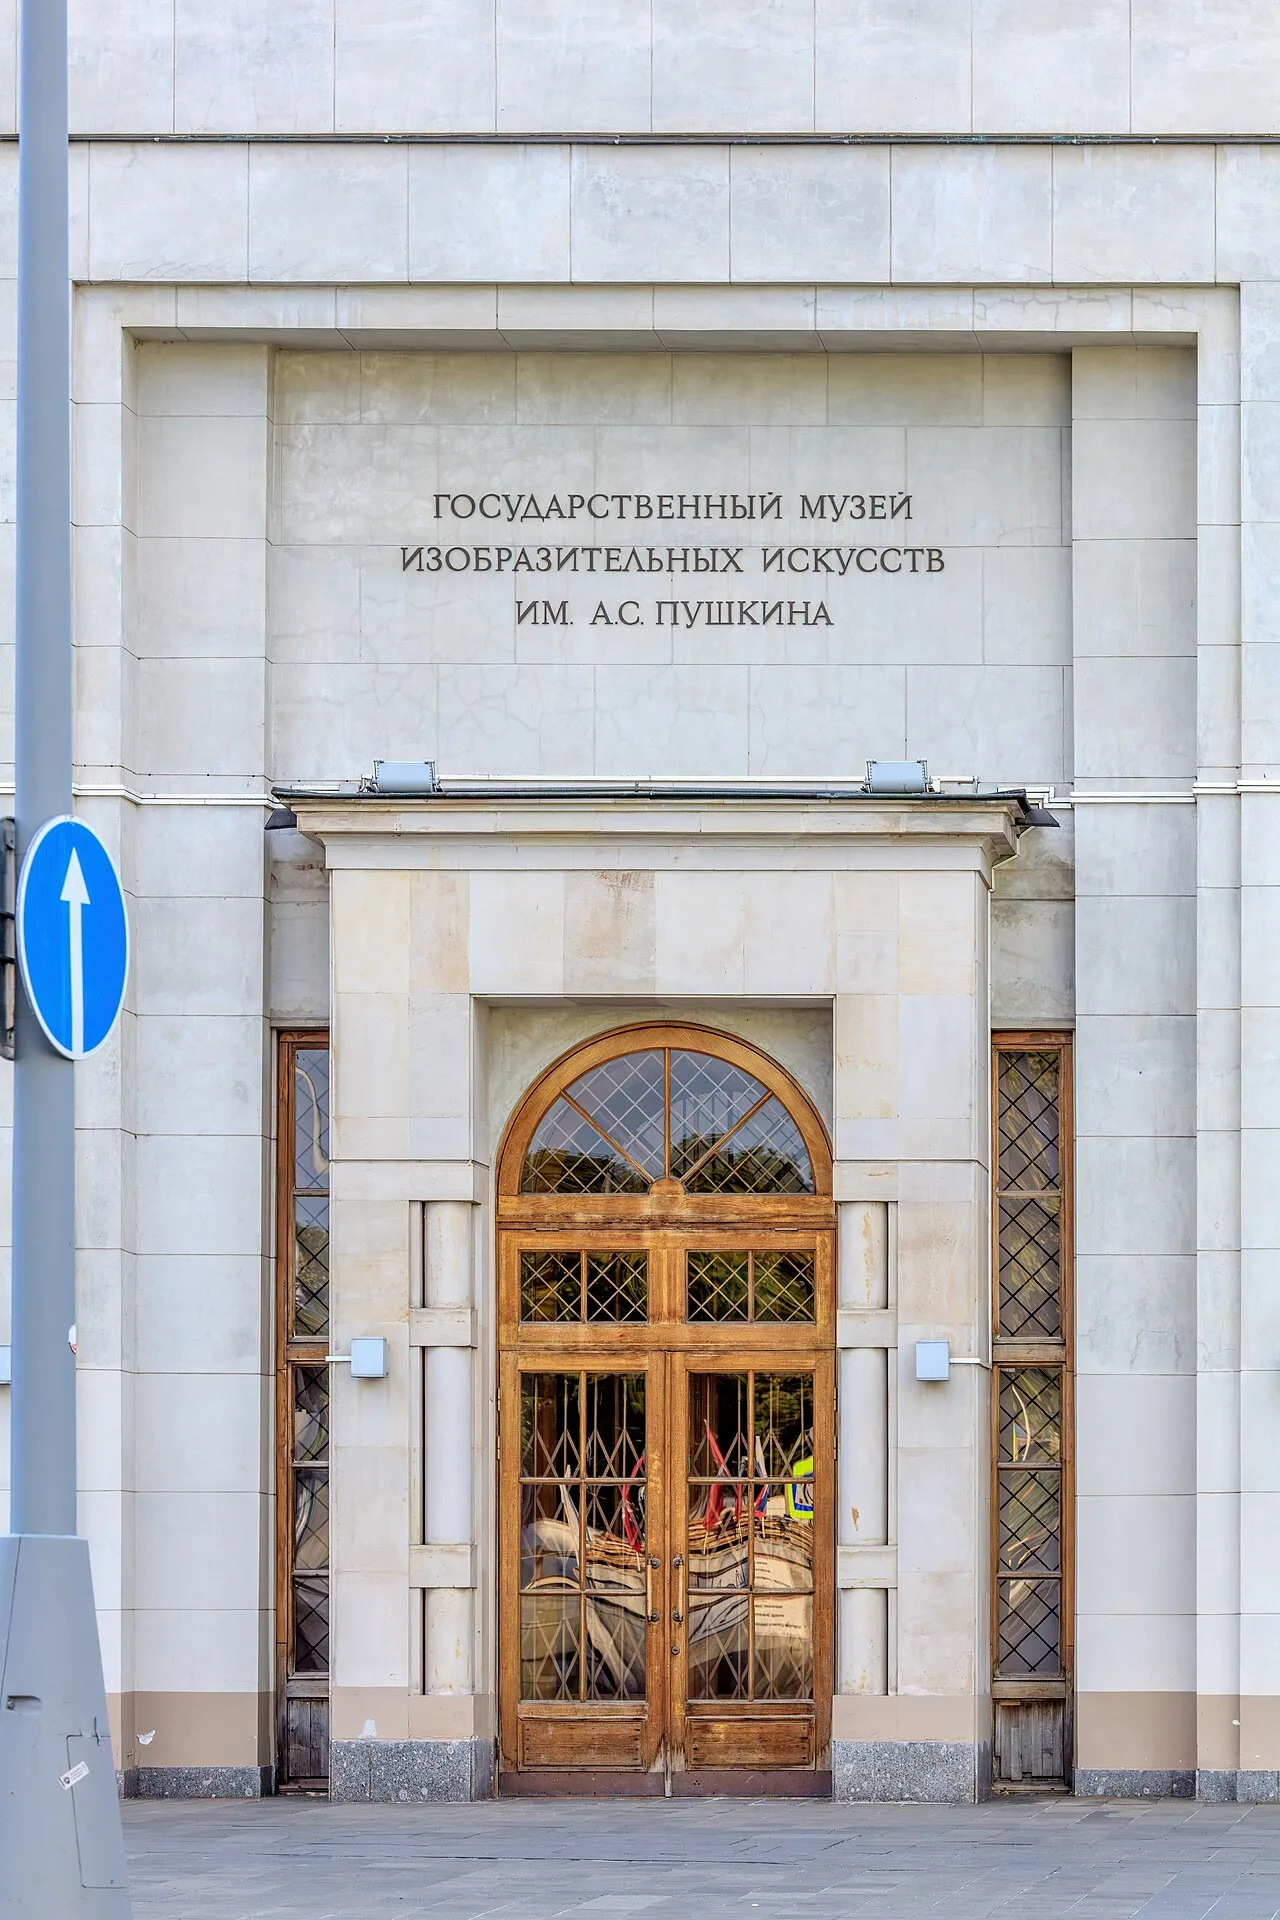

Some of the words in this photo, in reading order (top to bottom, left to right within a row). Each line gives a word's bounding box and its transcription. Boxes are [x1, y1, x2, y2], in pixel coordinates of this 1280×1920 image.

[433, 491, 782, 522] ГОСУДАРСТВЕННЫЙ
[800, 491, 913, 522] МУЗЕЙ
[400, 547, 744, 576] ИЗОБРАЗИТЕЛЬНЫХ
[761, 547, 945, 577] ИСКУССТВ
[515, 599, 573, 626] ИМ.
[589, 599, 644, 626] А.С.
[656, 599, 834, 629] ПУШКИНА
